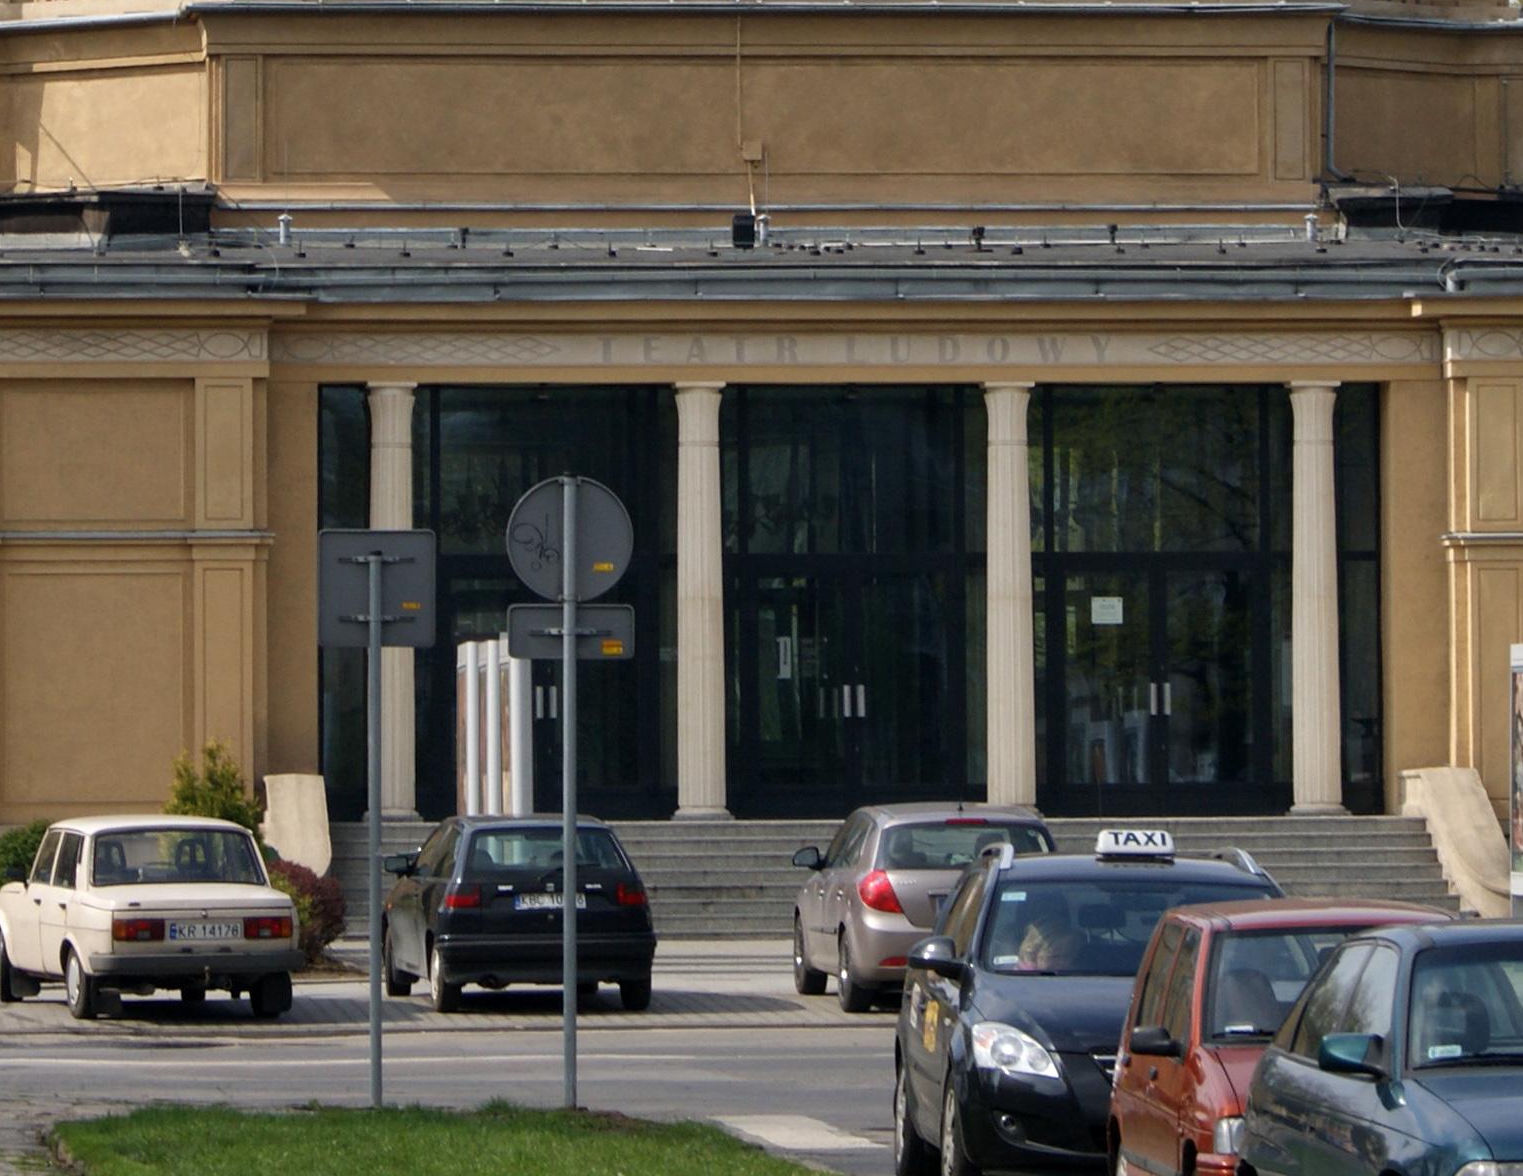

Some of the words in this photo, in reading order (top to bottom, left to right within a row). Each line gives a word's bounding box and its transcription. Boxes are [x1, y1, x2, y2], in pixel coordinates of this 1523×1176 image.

[597, 335, 799, 365] TEATR
[845, 335, 1114, 365] LUDOWY
[1107, 831, 1167, 846] TAXI
[178, 924, 197, 938] KR
